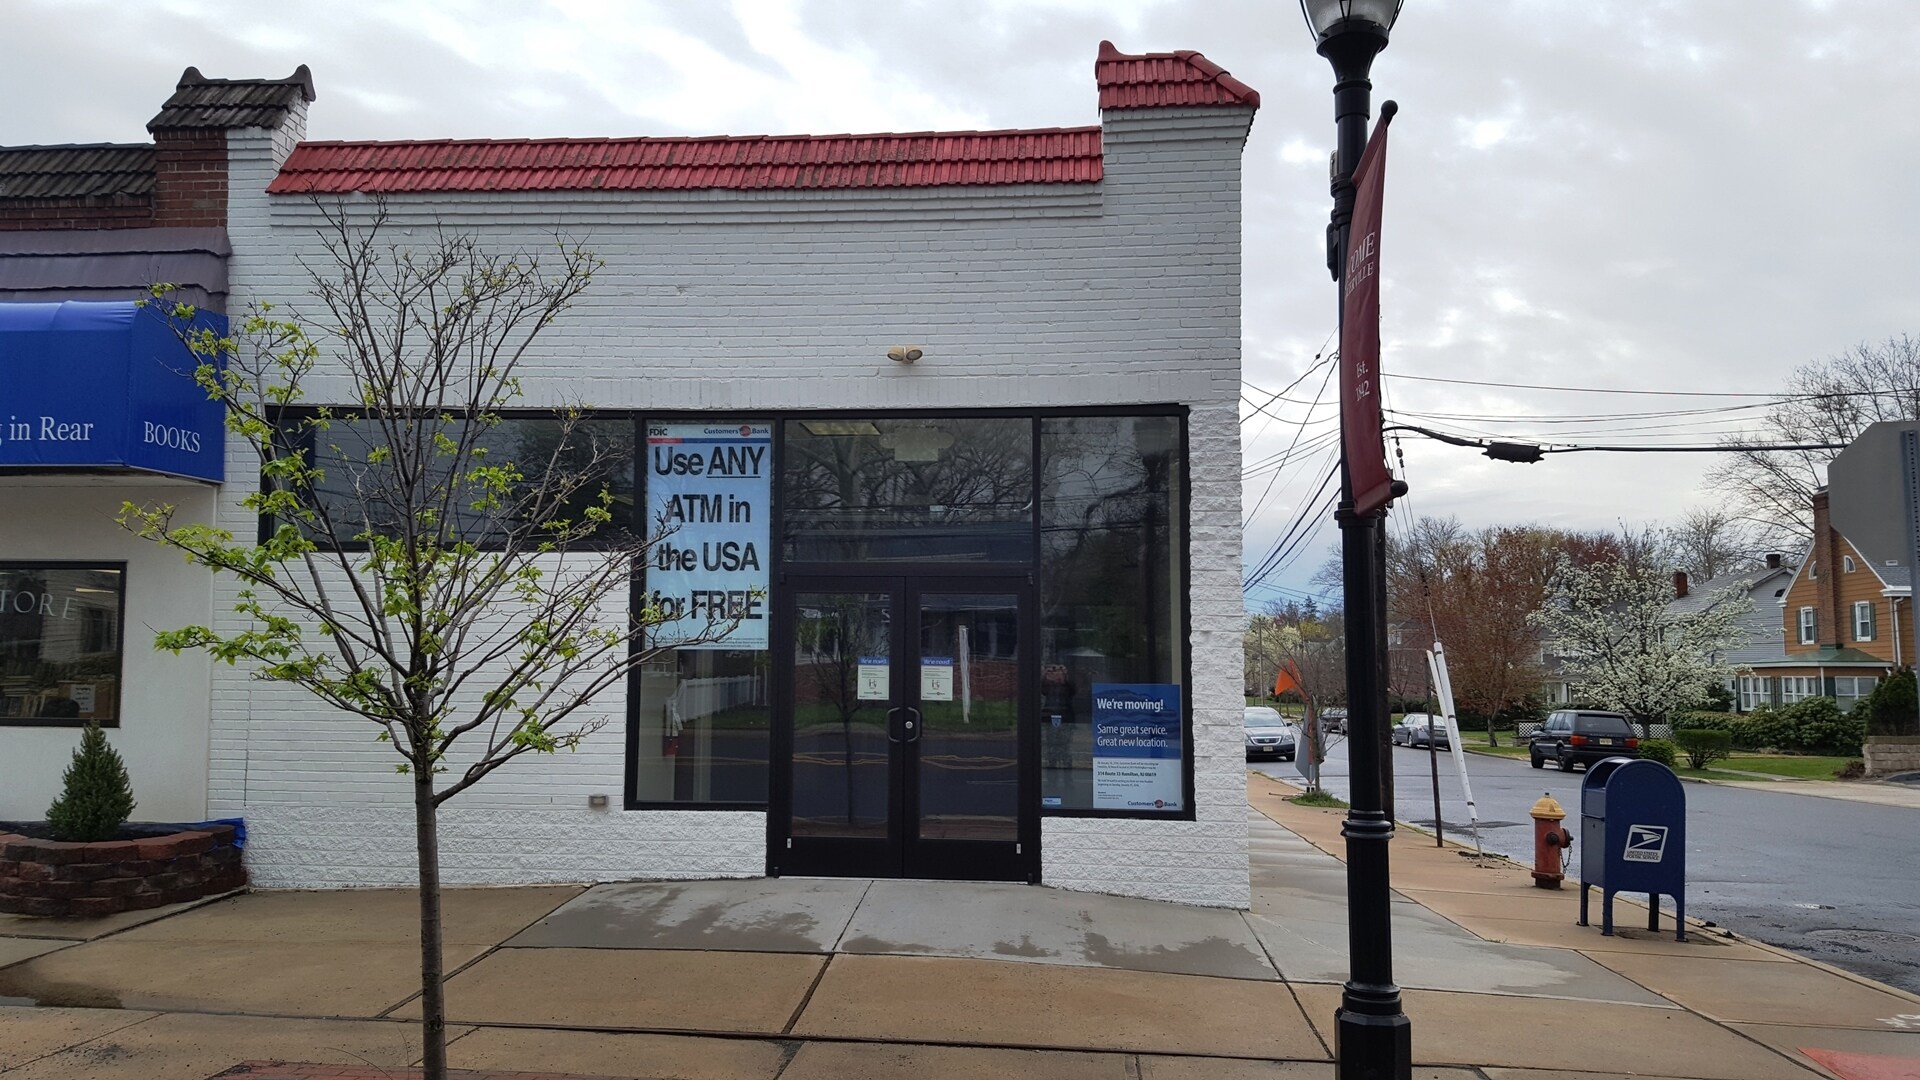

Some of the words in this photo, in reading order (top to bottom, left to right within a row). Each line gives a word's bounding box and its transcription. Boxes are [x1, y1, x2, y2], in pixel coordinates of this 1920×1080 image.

[1356, 360, 1368, 379] Est.
[9, 415, 31, 441] in
[39, 416, 94, 441] Rear
[143, 421, 201, 453] BOOKS
[649, 428, 668, 436] FDIC
[703, 427, 739, 435] Customers
[655, 446, 704, 476] Use
[707, 446, 766, 476] ANY
[663, 494, 722, 523] ATM
[729, 494, 751, 523] in
[658, 542, 698, 571] the
[703, 541, 760, 572] USA
[650, 590, 686, 619] for
[691, 590, 764, 620] FREE
[1097, 698, 1124, 710] We're
[1124, 698, 1164, 713] moving!
[1097, 723, 1119, 734] Same
[1120, 724, 1140, 737] great
[1140, 724, 1168, 735] service.
[1097, 736, 1118, 747] Great
[1118, 738, 1136, 747] new
[1136, 737, 1168, 748] location.
